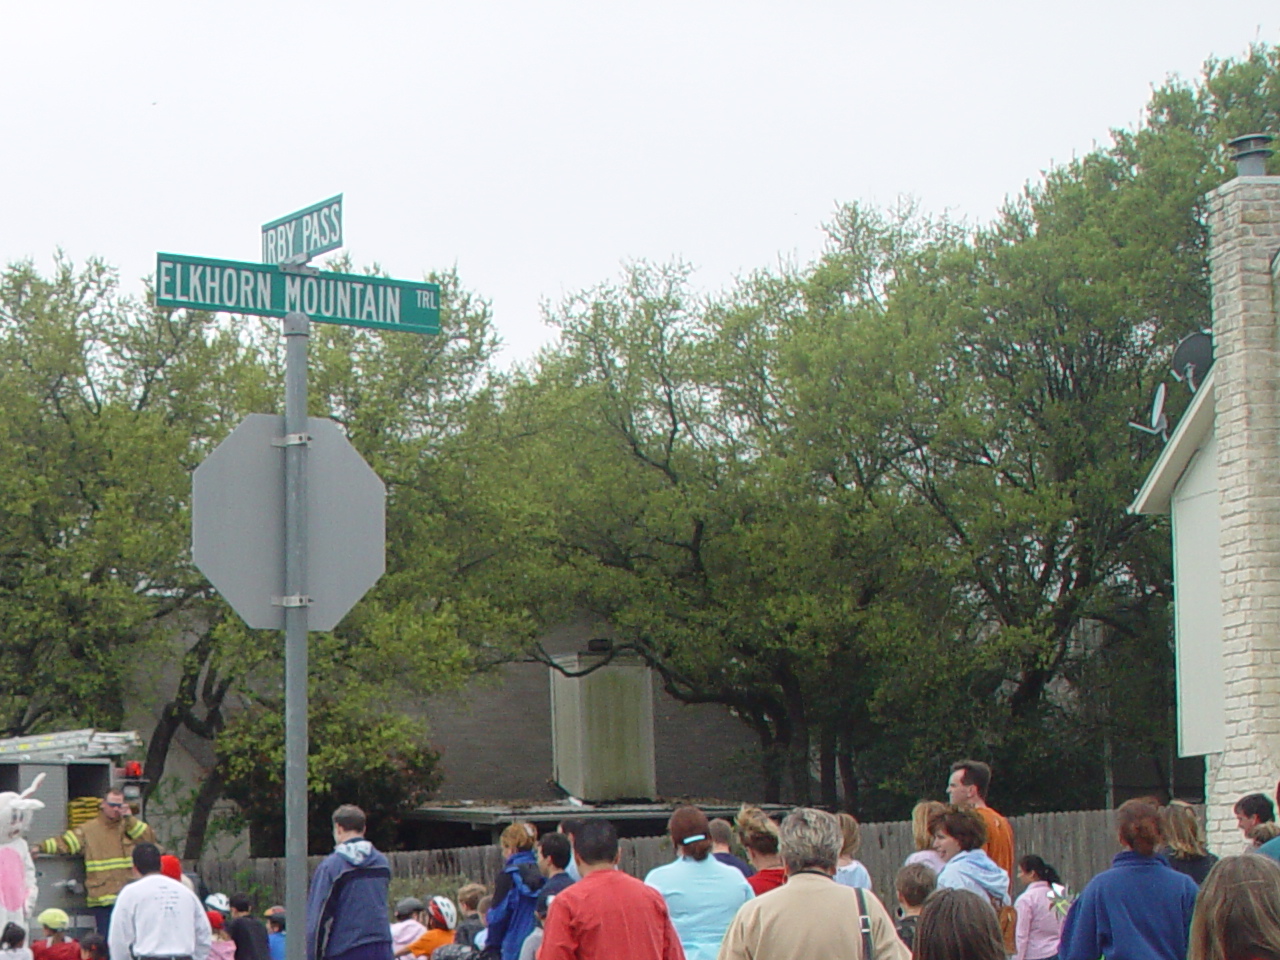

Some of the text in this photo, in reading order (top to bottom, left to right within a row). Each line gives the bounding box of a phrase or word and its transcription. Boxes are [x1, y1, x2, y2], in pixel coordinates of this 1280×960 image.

[303, 203, 340, 253] PASS
[160, 261, 438, 324] ELKHORN MOUNTAIN TRL
